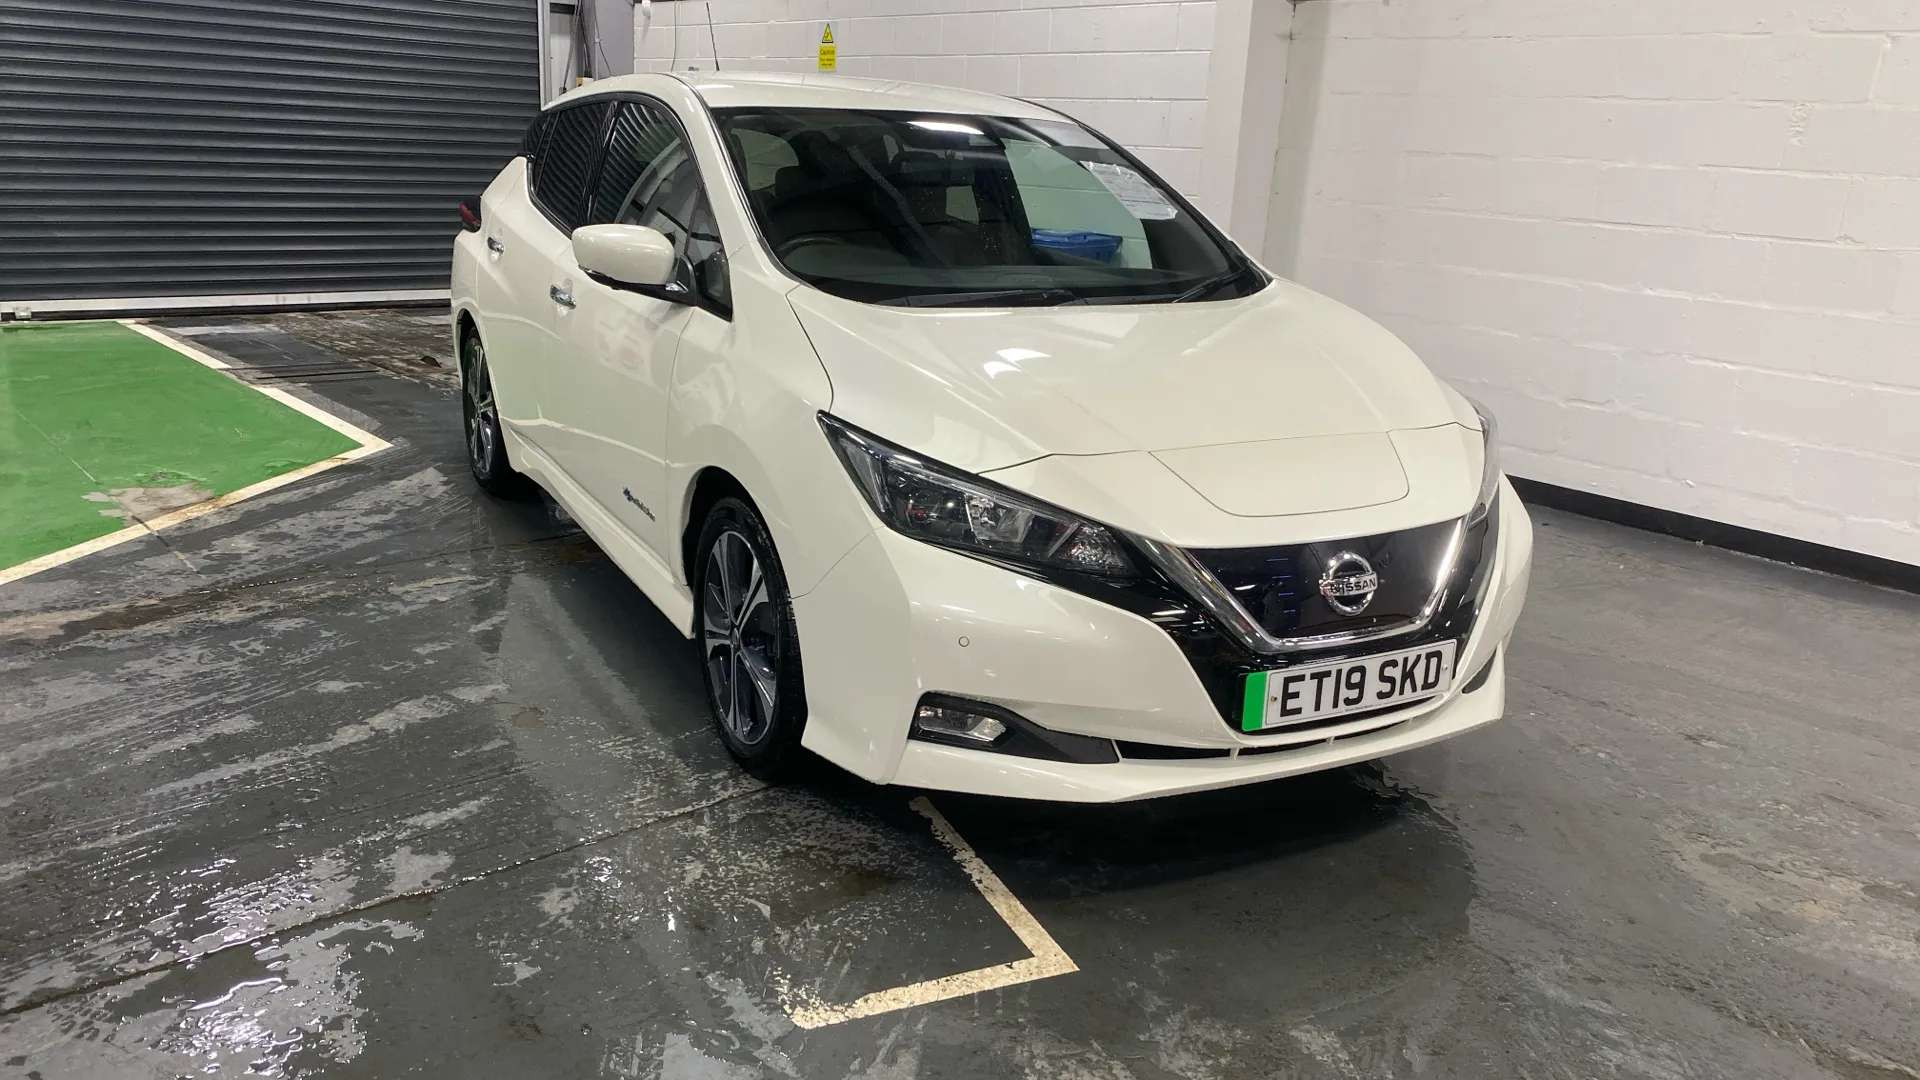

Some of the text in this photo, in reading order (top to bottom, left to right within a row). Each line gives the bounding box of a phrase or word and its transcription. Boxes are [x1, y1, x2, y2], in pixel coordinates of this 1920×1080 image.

[1330, 577, 1377, 595] NISSAN
[1280, 650, 1443, 718] ET19 SKD
